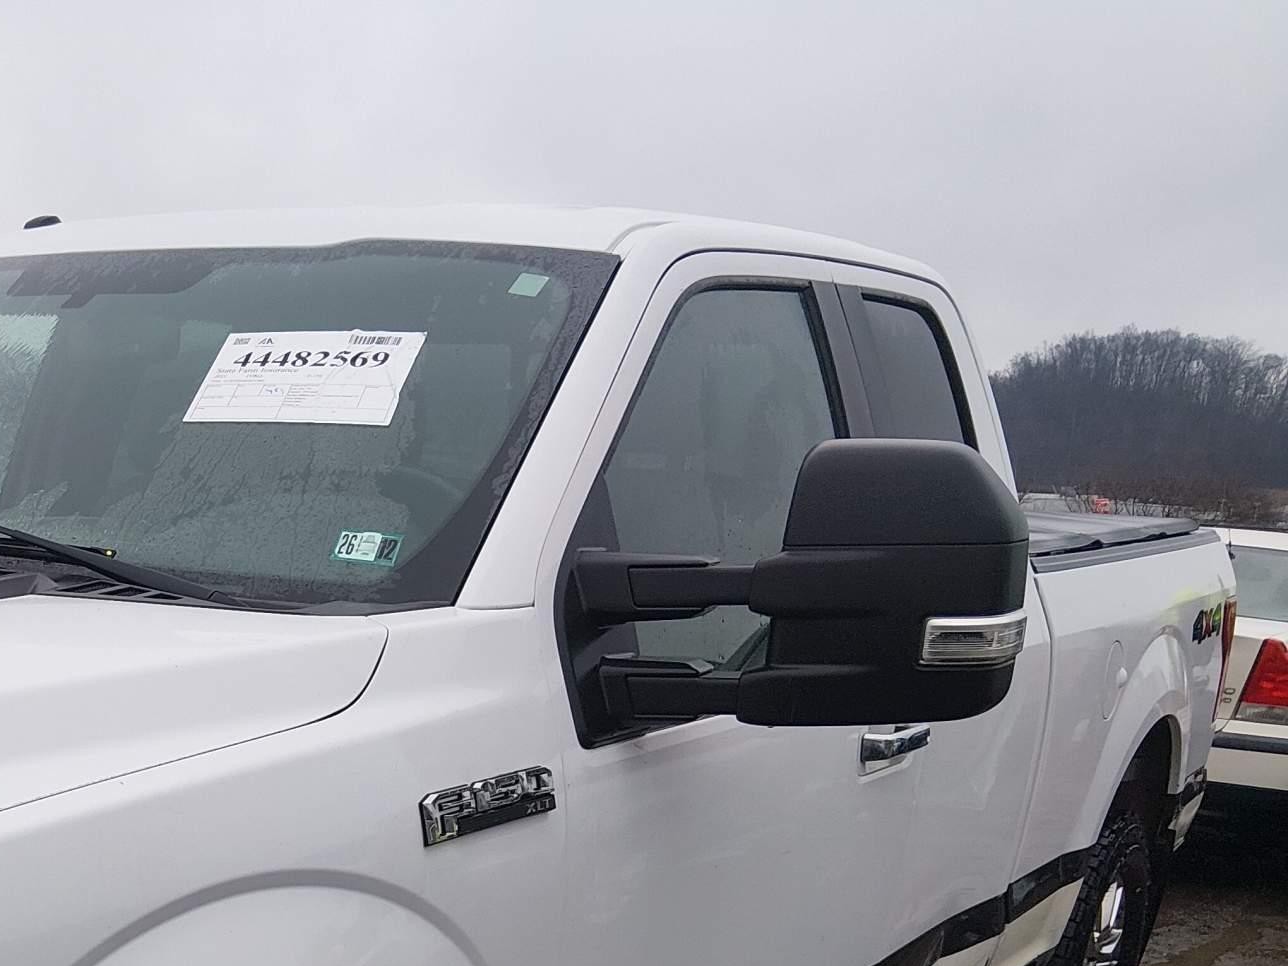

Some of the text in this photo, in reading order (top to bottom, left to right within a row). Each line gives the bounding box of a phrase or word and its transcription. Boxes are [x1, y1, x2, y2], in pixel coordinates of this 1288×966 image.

[232, 350, 391, 368] 44482569
[337, 533, 358, 555] 26
[525, 797, 553, 816] XLT
